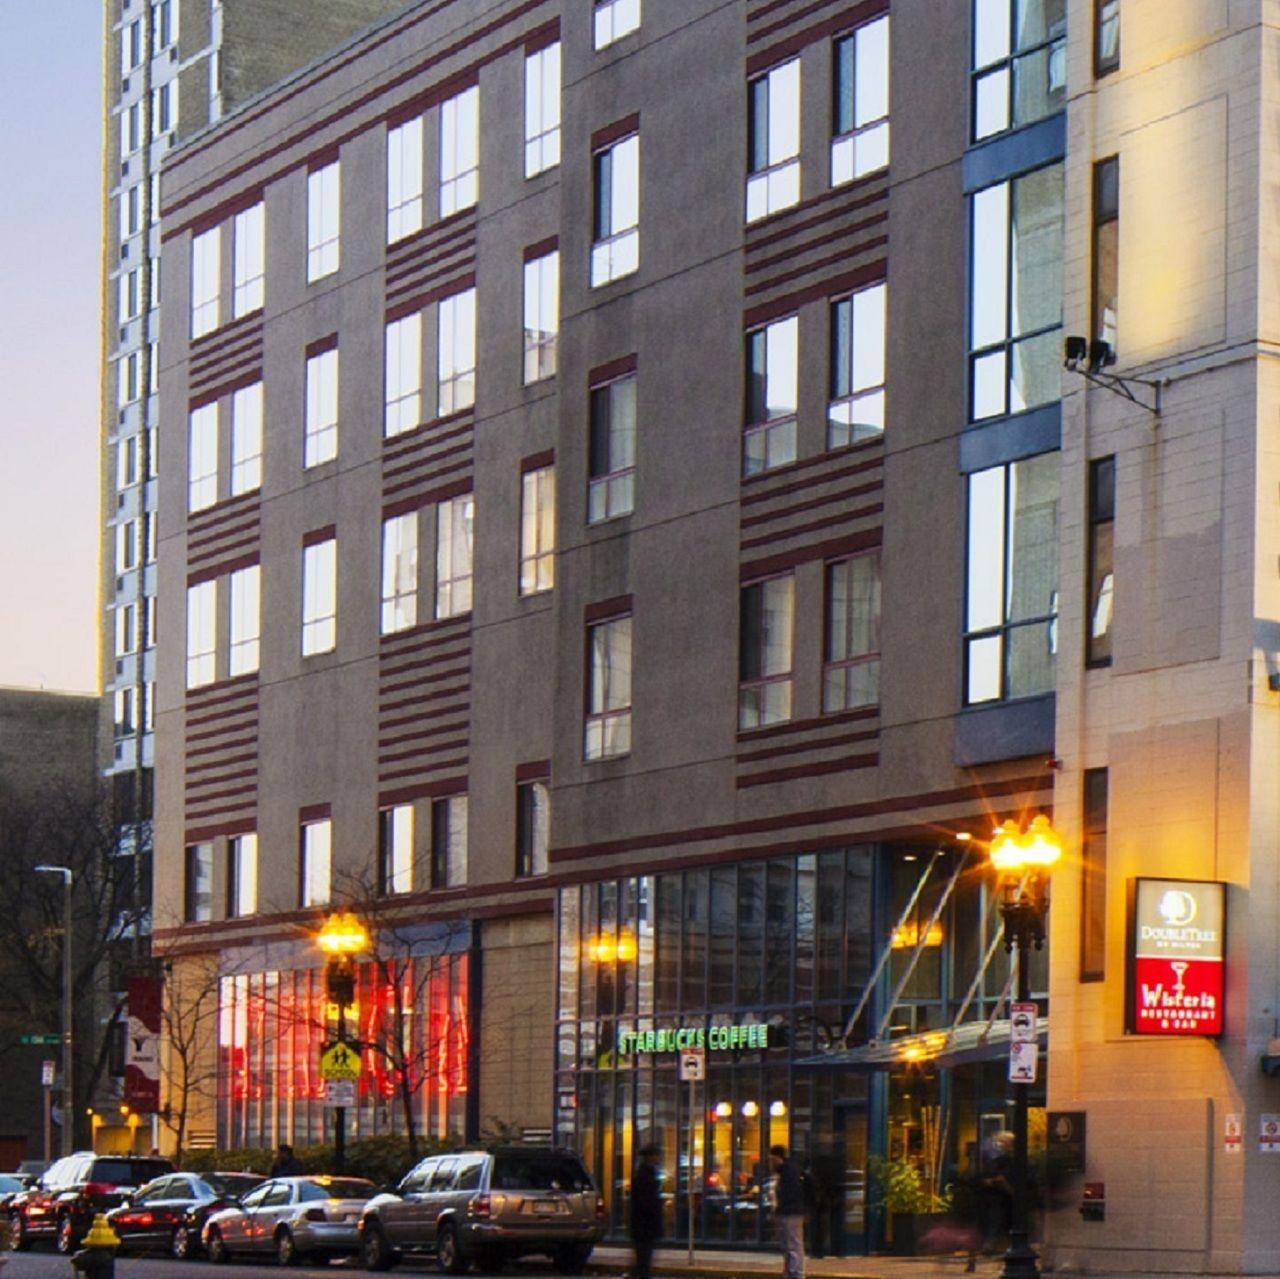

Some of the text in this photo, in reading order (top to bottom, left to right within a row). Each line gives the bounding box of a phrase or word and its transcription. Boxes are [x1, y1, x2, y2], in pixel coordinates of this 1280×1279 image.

[1142, 983, 1216, 1008] Wisteria
[1141, 1008, 1216, 1020] RESTAURANT
[1174, 1019, 1197, 1029] BAR
[620, 1024, 768, 1054] STARBUCKS COFFEE
